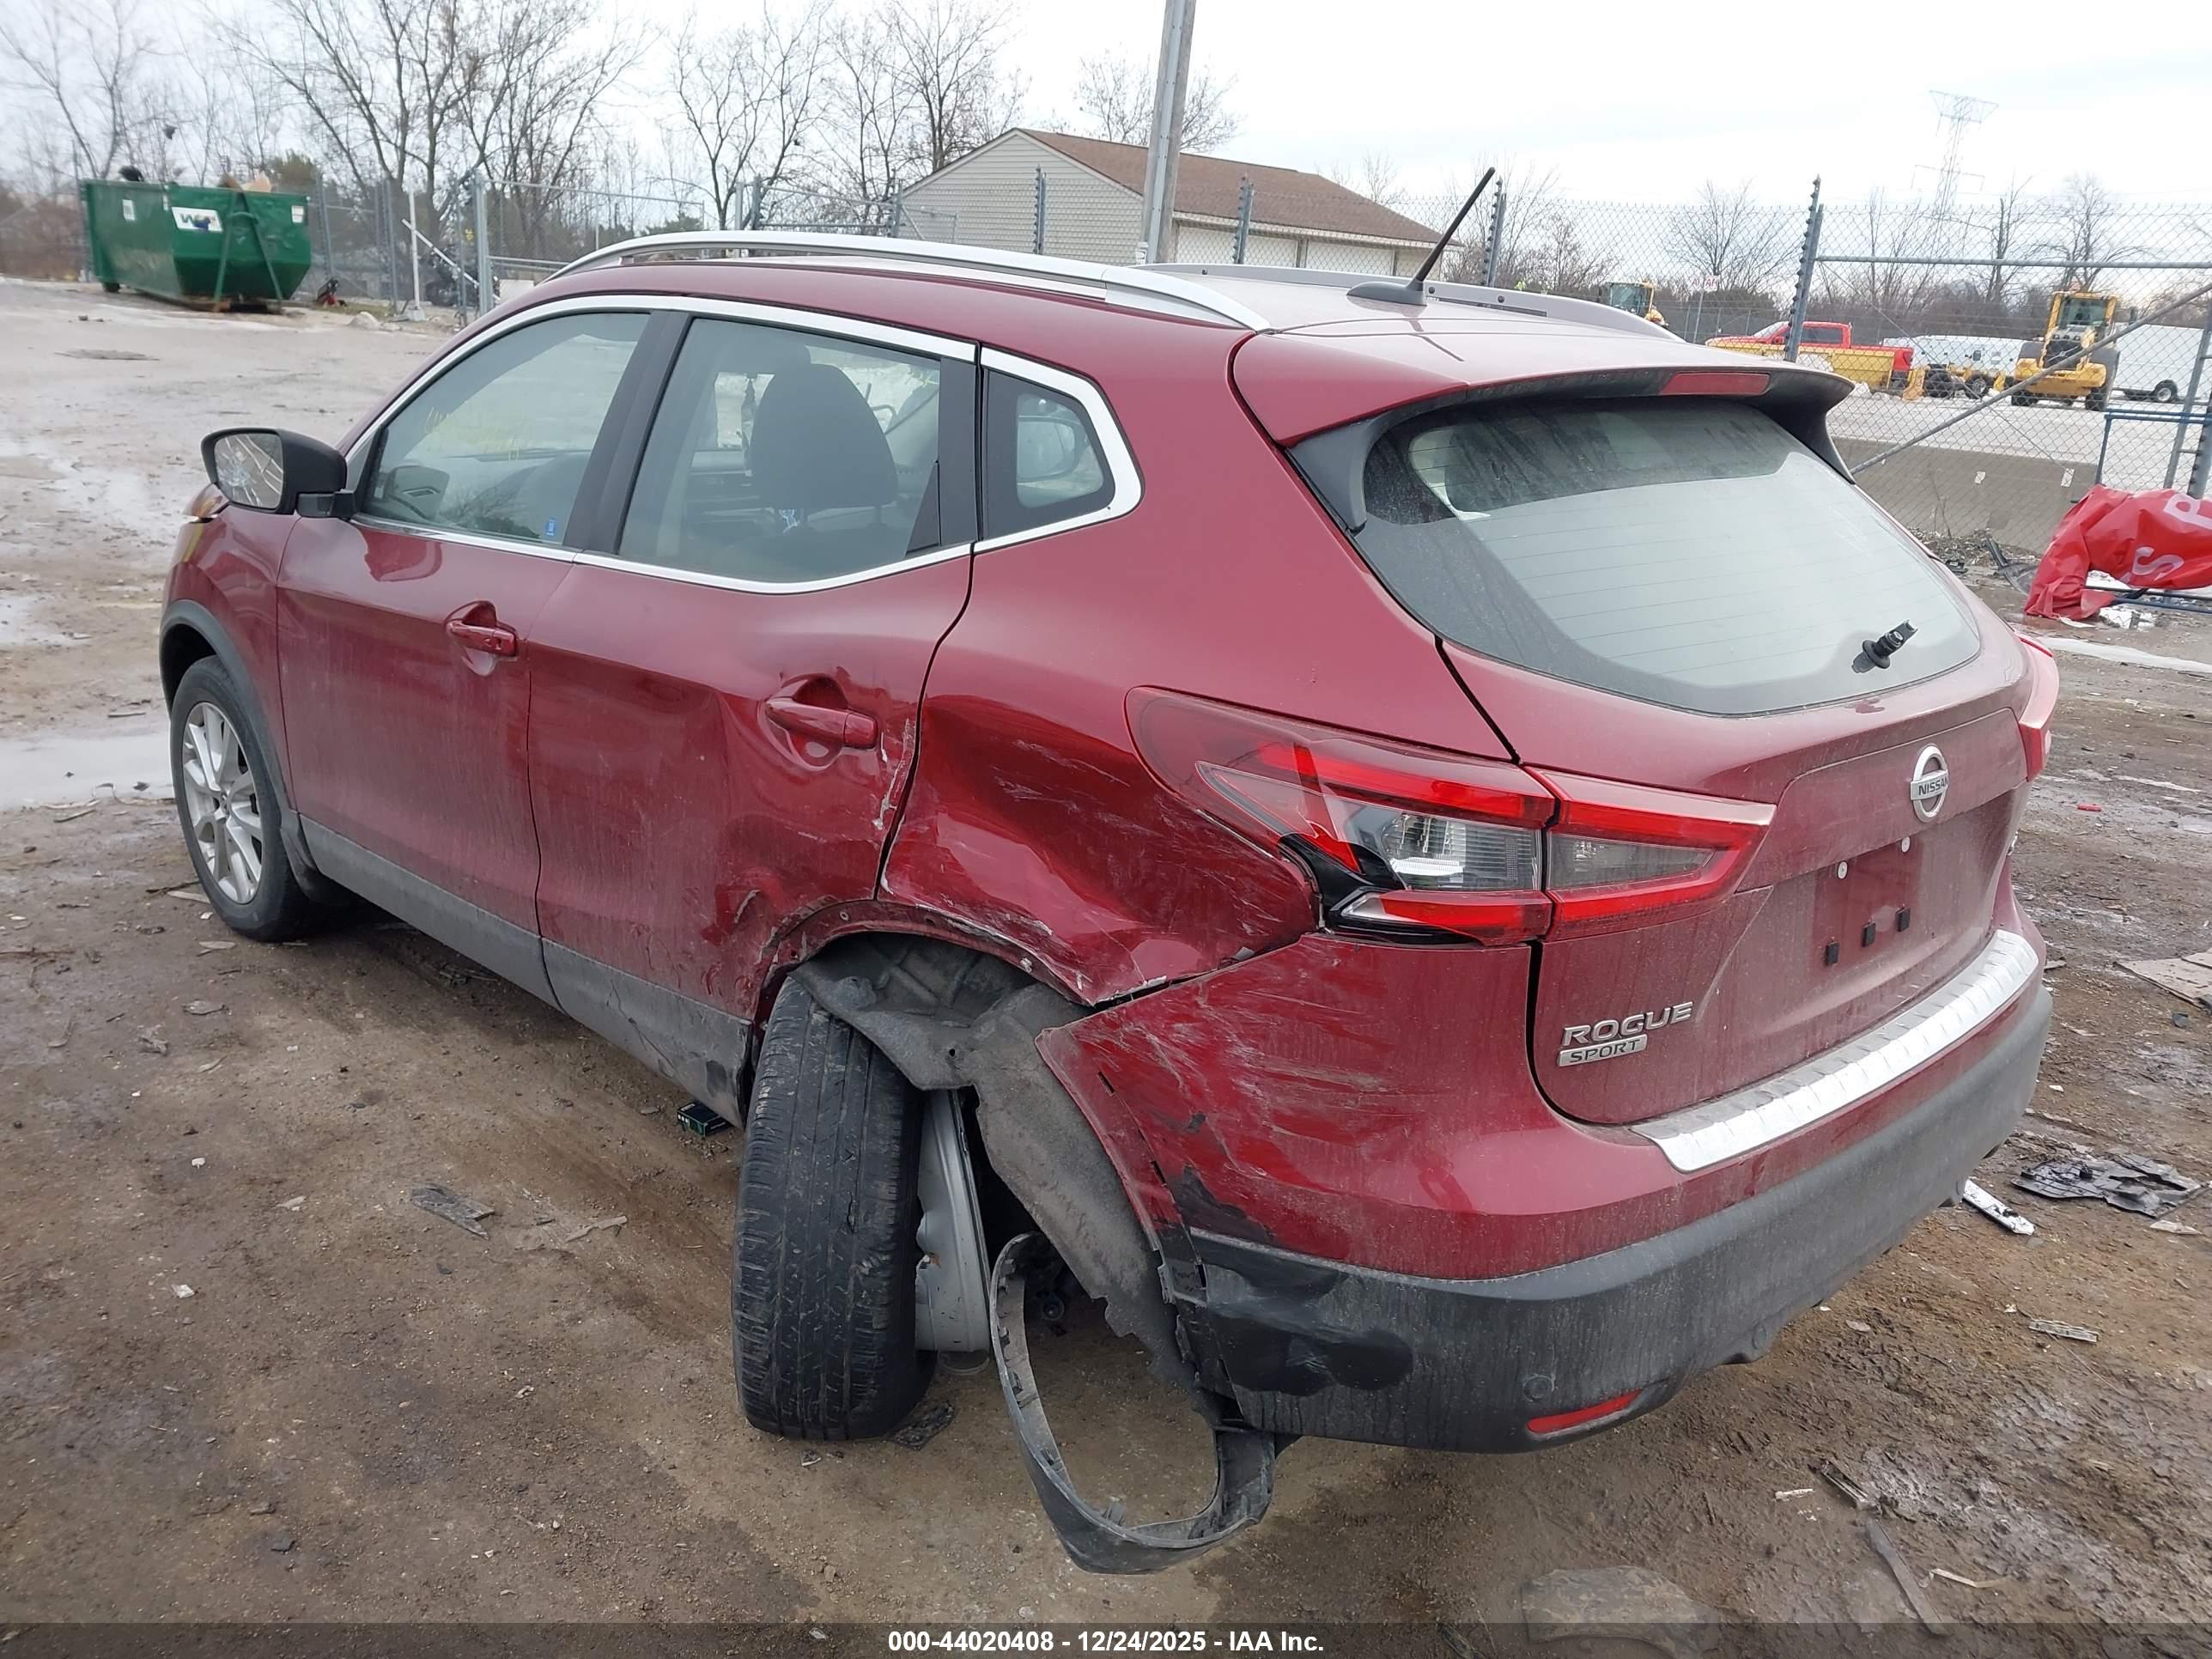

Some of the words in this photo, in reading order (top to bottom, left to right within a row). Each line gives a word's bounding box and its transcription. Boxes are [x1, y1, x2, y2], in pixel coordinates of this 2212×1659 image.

[1918, 776, 1948, 795] NISSAN
[1562, 1001, 1693, 1047] ROGUE
[1570, 1039, 1640, 1063] SPORT
